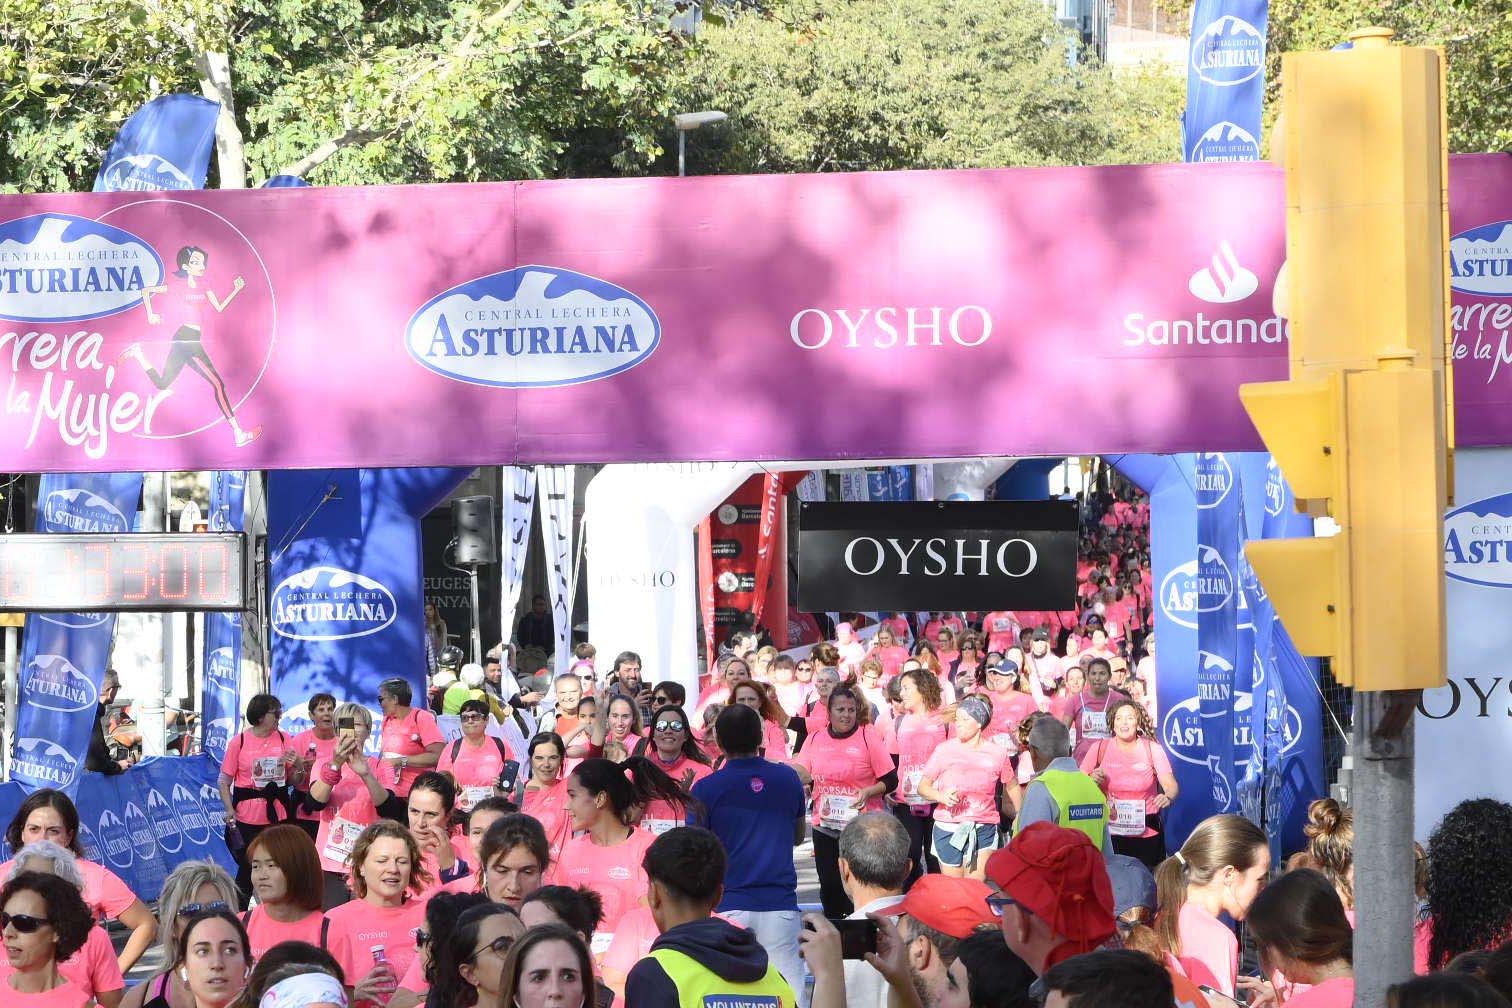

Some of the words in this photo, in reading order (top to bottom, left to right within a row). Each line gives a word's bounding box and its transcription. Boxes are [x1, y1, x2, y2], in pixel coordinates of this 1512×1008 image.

[68, 249, 139, 262] LECHERA
[464, 308, 543, 322] CENTRAL
[551, 306, 632, 320] LECHERA
[790, 305, 992, 350] OYSHO
[1123, 312, 1289, 346] Santand
[425, 312, 640, 358] ASTURIANA
[1474, 332, 1491, 359] la
[5, 375, 30, 414] la
[25, 363, 175, 460] Mujer
[844, 536, 1038, 577] OYSHO
[274, 596, 388, 624] ASTURIANA
[288, 592, 329, 600] CENTRAL
